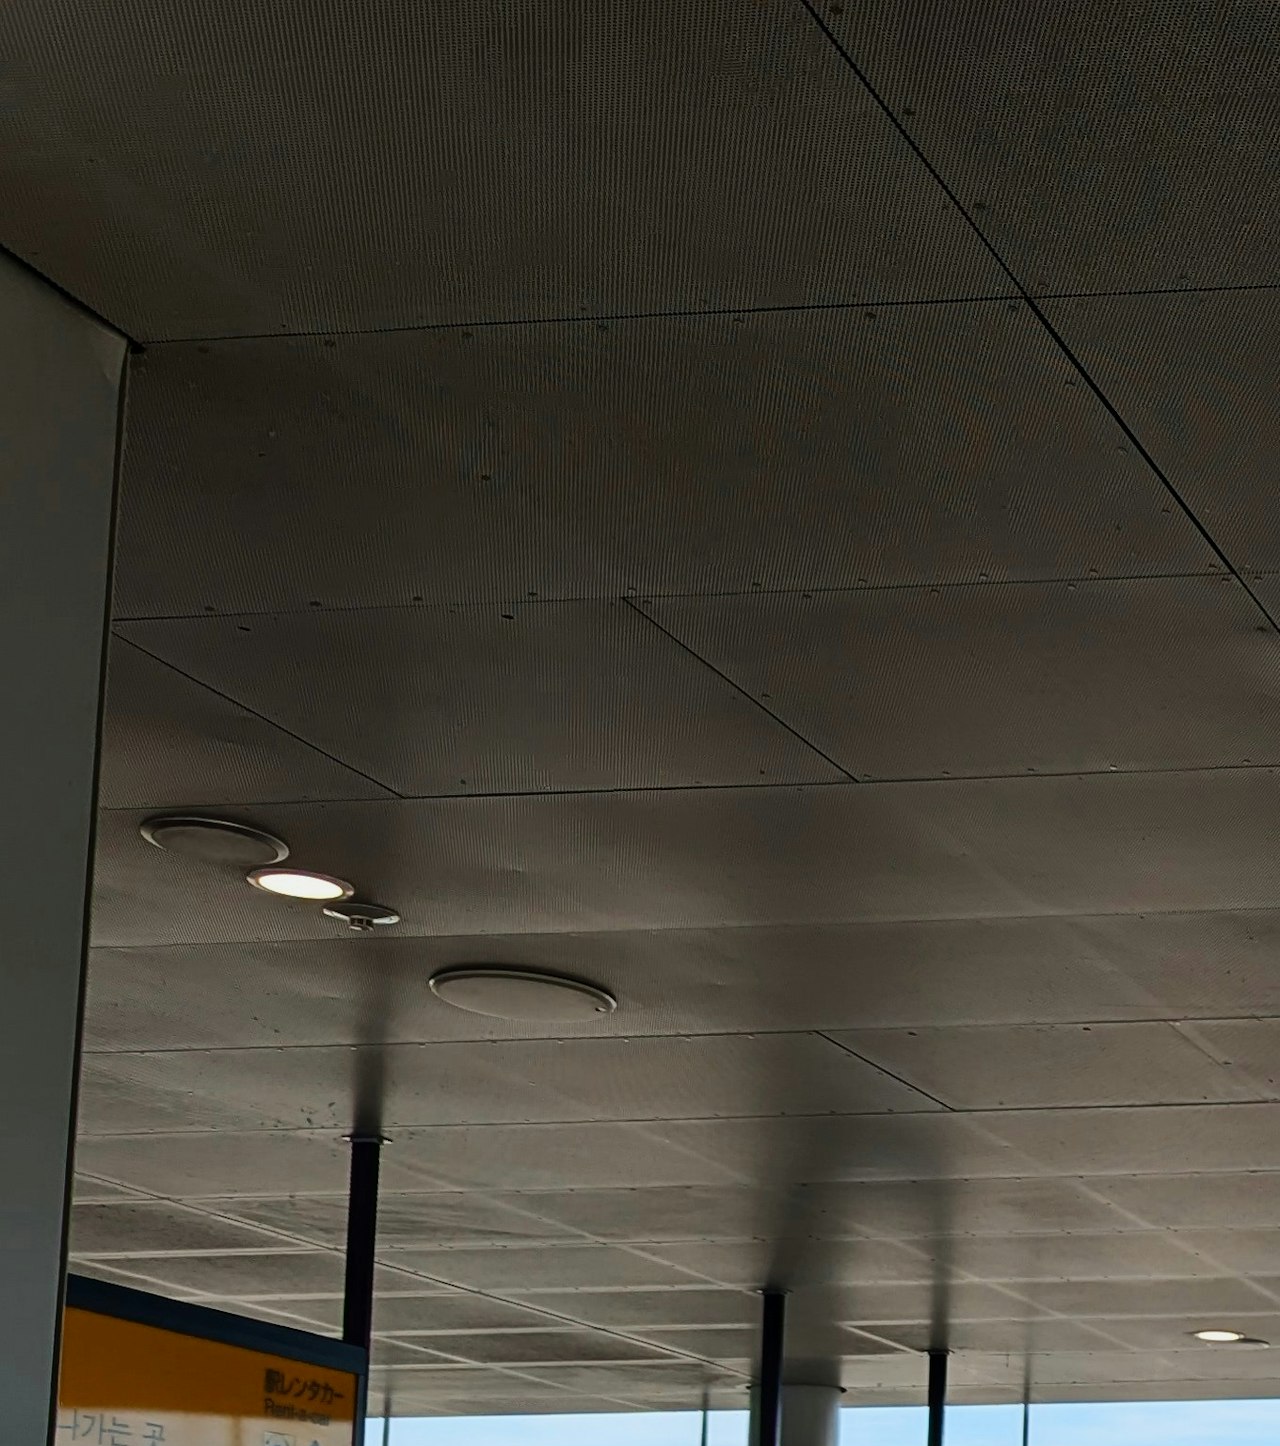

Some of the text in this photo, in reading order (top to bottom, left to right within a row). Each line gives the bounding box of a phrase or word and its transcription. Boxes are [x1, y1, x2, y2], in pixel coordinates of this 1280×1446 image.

[264, 1369, 345, 1405] 駅レンタカー
